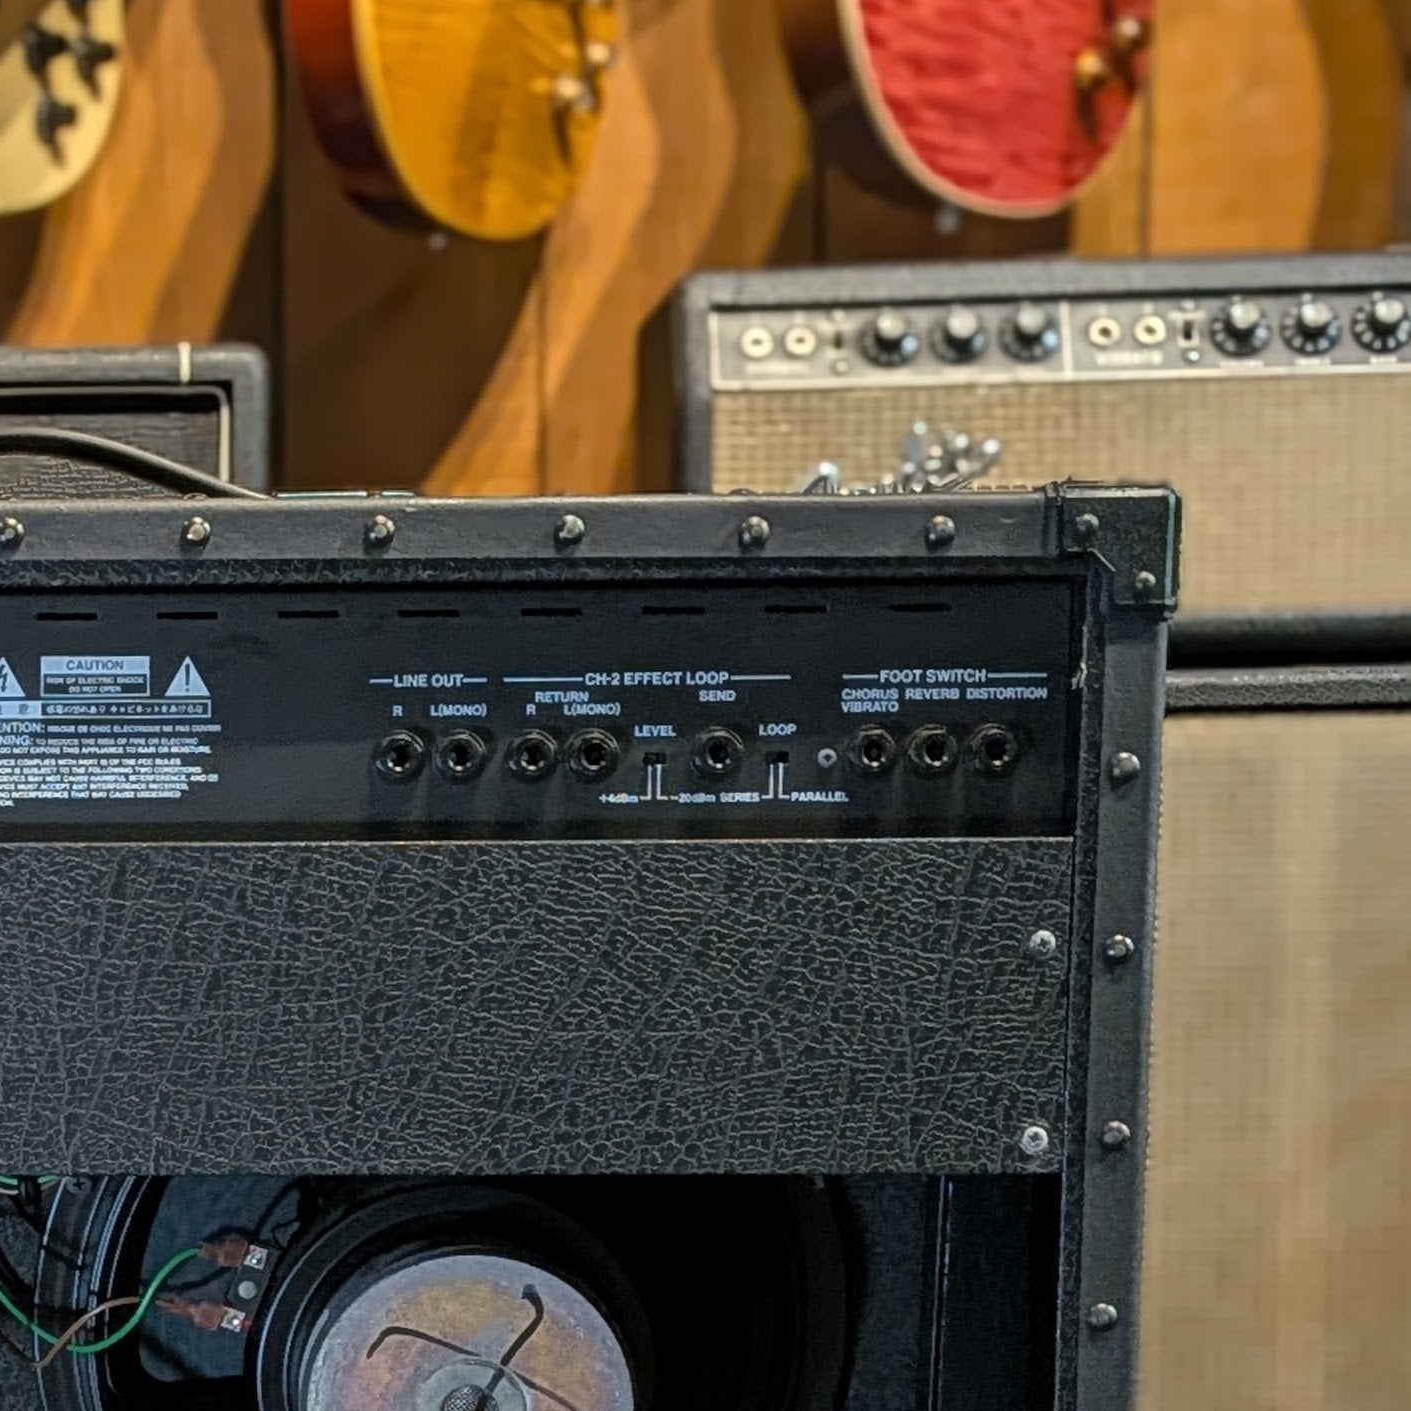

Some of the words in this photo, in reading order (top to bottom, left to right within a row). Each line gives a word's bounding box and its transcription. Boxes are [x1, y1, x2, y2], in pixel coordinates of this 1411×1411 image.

[65, 659, 124, 671] CAUTION
[393, 674, 428, 687] LINE
[431, 674, 464, 687] OUT
[584, 672, 621, 686] CH-2
[623, 672, 683, 686] EFFECT
[686, 671, 730, 685] LOOP
[879, 669, 923, 683] FOOT
[926, 668, 987, 683] SWITCH
[82, 685, 98, 693] NOT
[99, 685, 122, 693] OPEN
[698, 689, 737, 702] SEND
[841, 688, 899, 700] CHORUS
[905, 687, 960, 700] REVERB
[966, 687, 1048, 699] DISTORTION
[534, 690, 589, 703] RETURN
[392, 705, 403, 717] R
[430, 703, 487, 717] L(MONO)
[526, 703, 536, 715] R
[564, 702, 621, 716] L(MONO)
[841, 700, 899, 713] VIBRATO
[634, 725, 677, 737] LEVEL
[758, 723, 797, 736] LOOP
[719, 791, 760, 803] SERIES
[791, 791, 849, 802] PARALLEL
